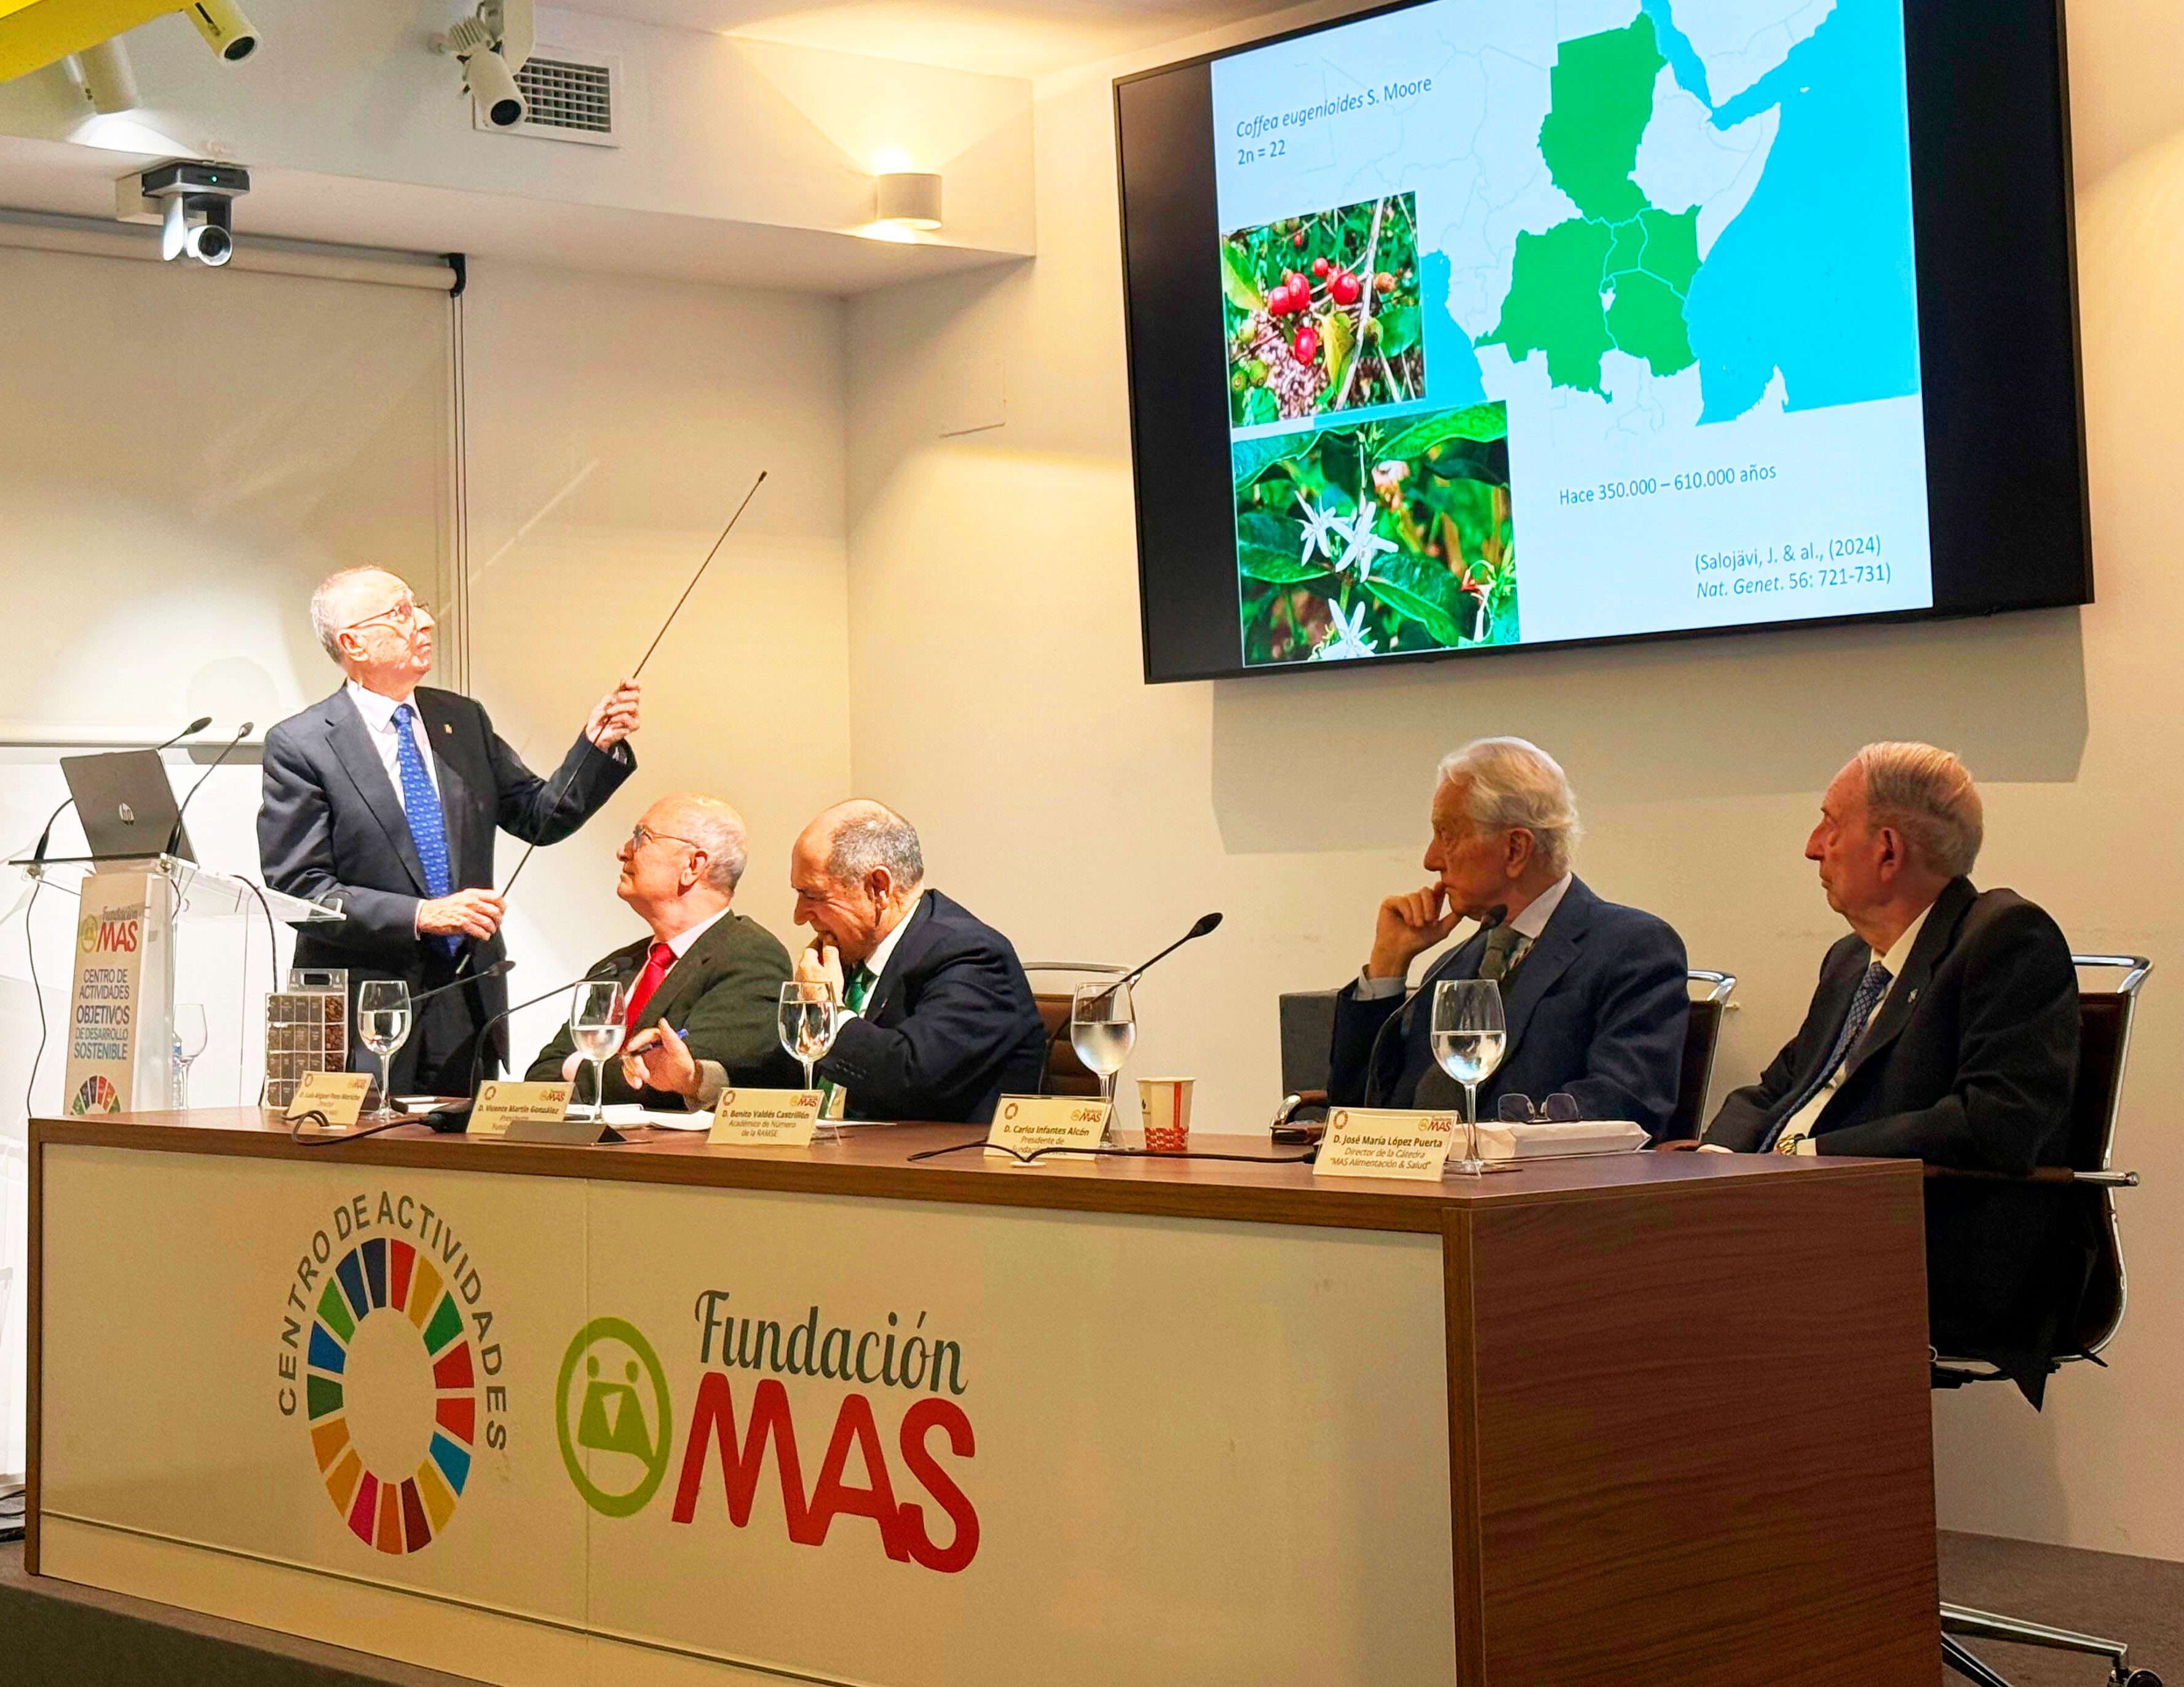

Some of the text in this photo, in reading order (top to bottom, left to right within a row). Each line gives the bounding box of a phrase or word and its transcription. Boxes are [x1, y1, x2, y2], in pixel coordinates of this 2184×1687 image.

[1236, 78, 1432, 138] Coffea eugenioides S. Moore
[1238, 139, 1286, 165] 2n = 22
[1559, 488, 1594, 506] Hace
[1598, 478, 1657, 500] 350.000
[1674, 467, 1735, 491] 610.000
[1739, 463, 1776, 483] años
[1695, 534, 1881, 575] (Salojävi, J. & al., (2024)
[1696, 563, 1891, 599] Nat. Genet. 56: 721-731)
[96, 921, 138, 952] MAS
[84, 969, 129, 983] CENTRO DE
[79, 985, 130, 1000] ACTIVIDADES
[76, 1005, 130, 1025] OBJETIVOS
[75, 1027, 129, 1040] DE DESARROLLO
[74, 1041, 129, 1060] SOSTENIBLE
[1079, 1112, 1102, 1123] MAS
[1427, 1121, 1451, 1132] MAS
[1013, 1125, 1034, 1134] Carlos
[1036, 1126, 1066, 1135] Infantes
[1067, 1127, 1090, 1136] Alcón
[1333, 1135, 1442, 1148] D. José María López Puerta
[1344, 1147, 1375, 1157] Director
[1376, 1148, 1386, 1157] de
[1395, 1149, 1426, 1159] Cátedra
[1350, 1158, 1397, 1168] Alimentación
[279, 1190, 507, 1451] CENTRO DE ACTIVIDADES
[695, 1289, 968, 1395] Fundación
[671, 1371, 980, 1573] MAS
